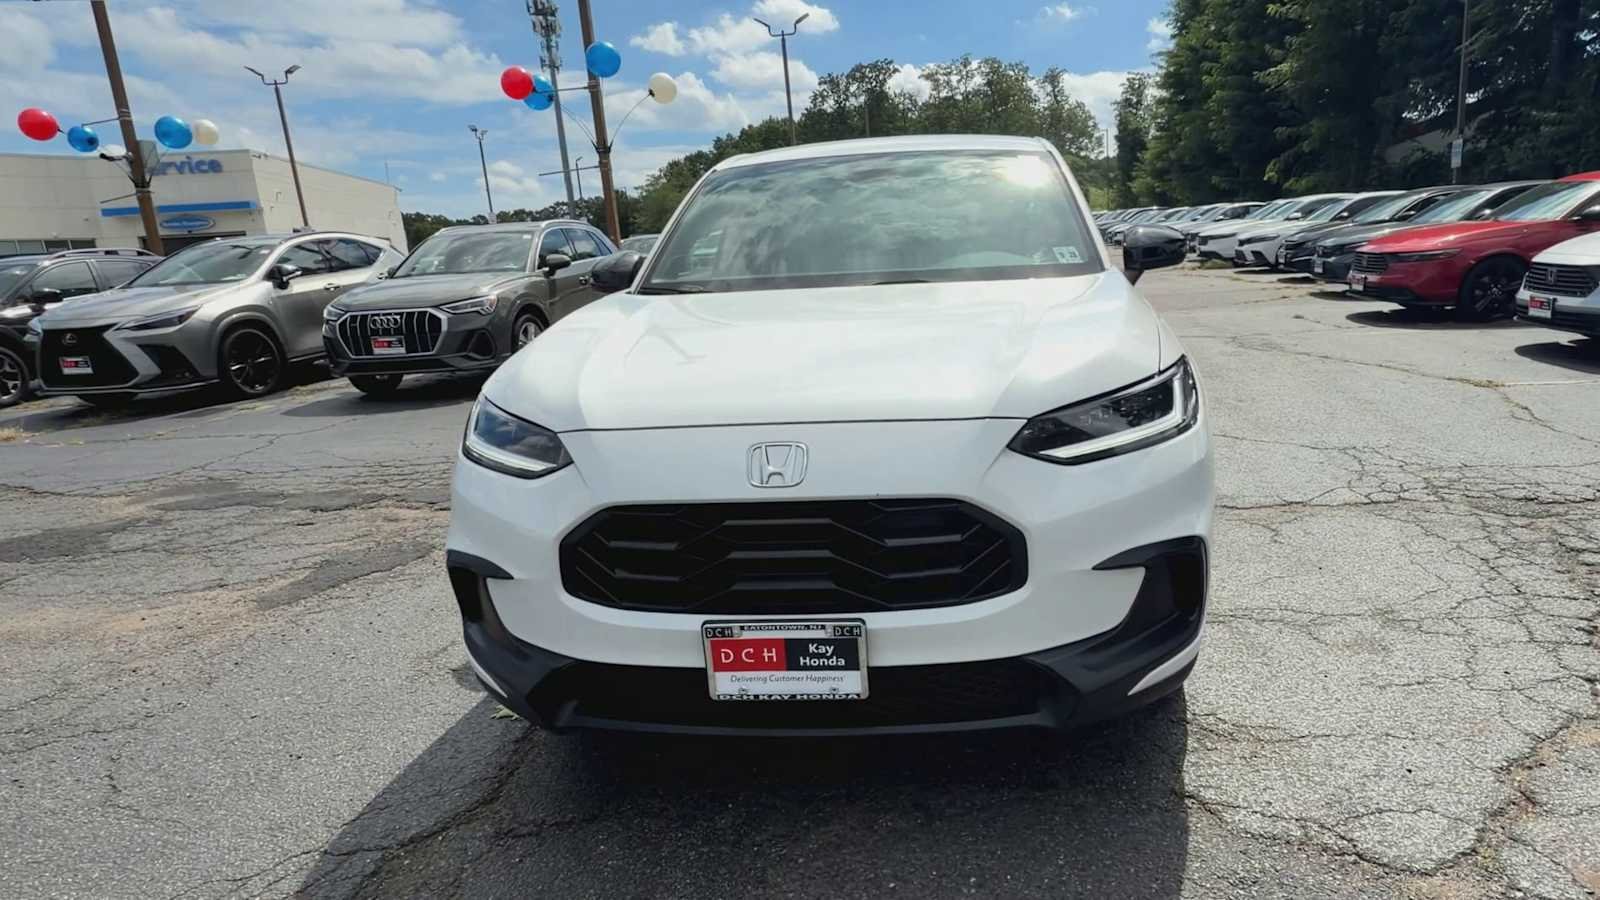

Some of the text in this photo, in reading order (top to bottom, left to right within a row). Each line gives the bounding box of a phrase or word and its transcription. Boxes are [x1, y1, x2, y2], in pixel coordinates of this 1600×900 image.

[146, 155, 223, 176] ervice
[706, 628, 732, 638] DCH
[834, 625, 861, 636] DCH
[720, 647, 777, 663] DCH
[808, 643, 835, 656] Kay
[799, 656, 846, 667] Honda
[730, 674, 843, 684] Delivering Customer Happiness
